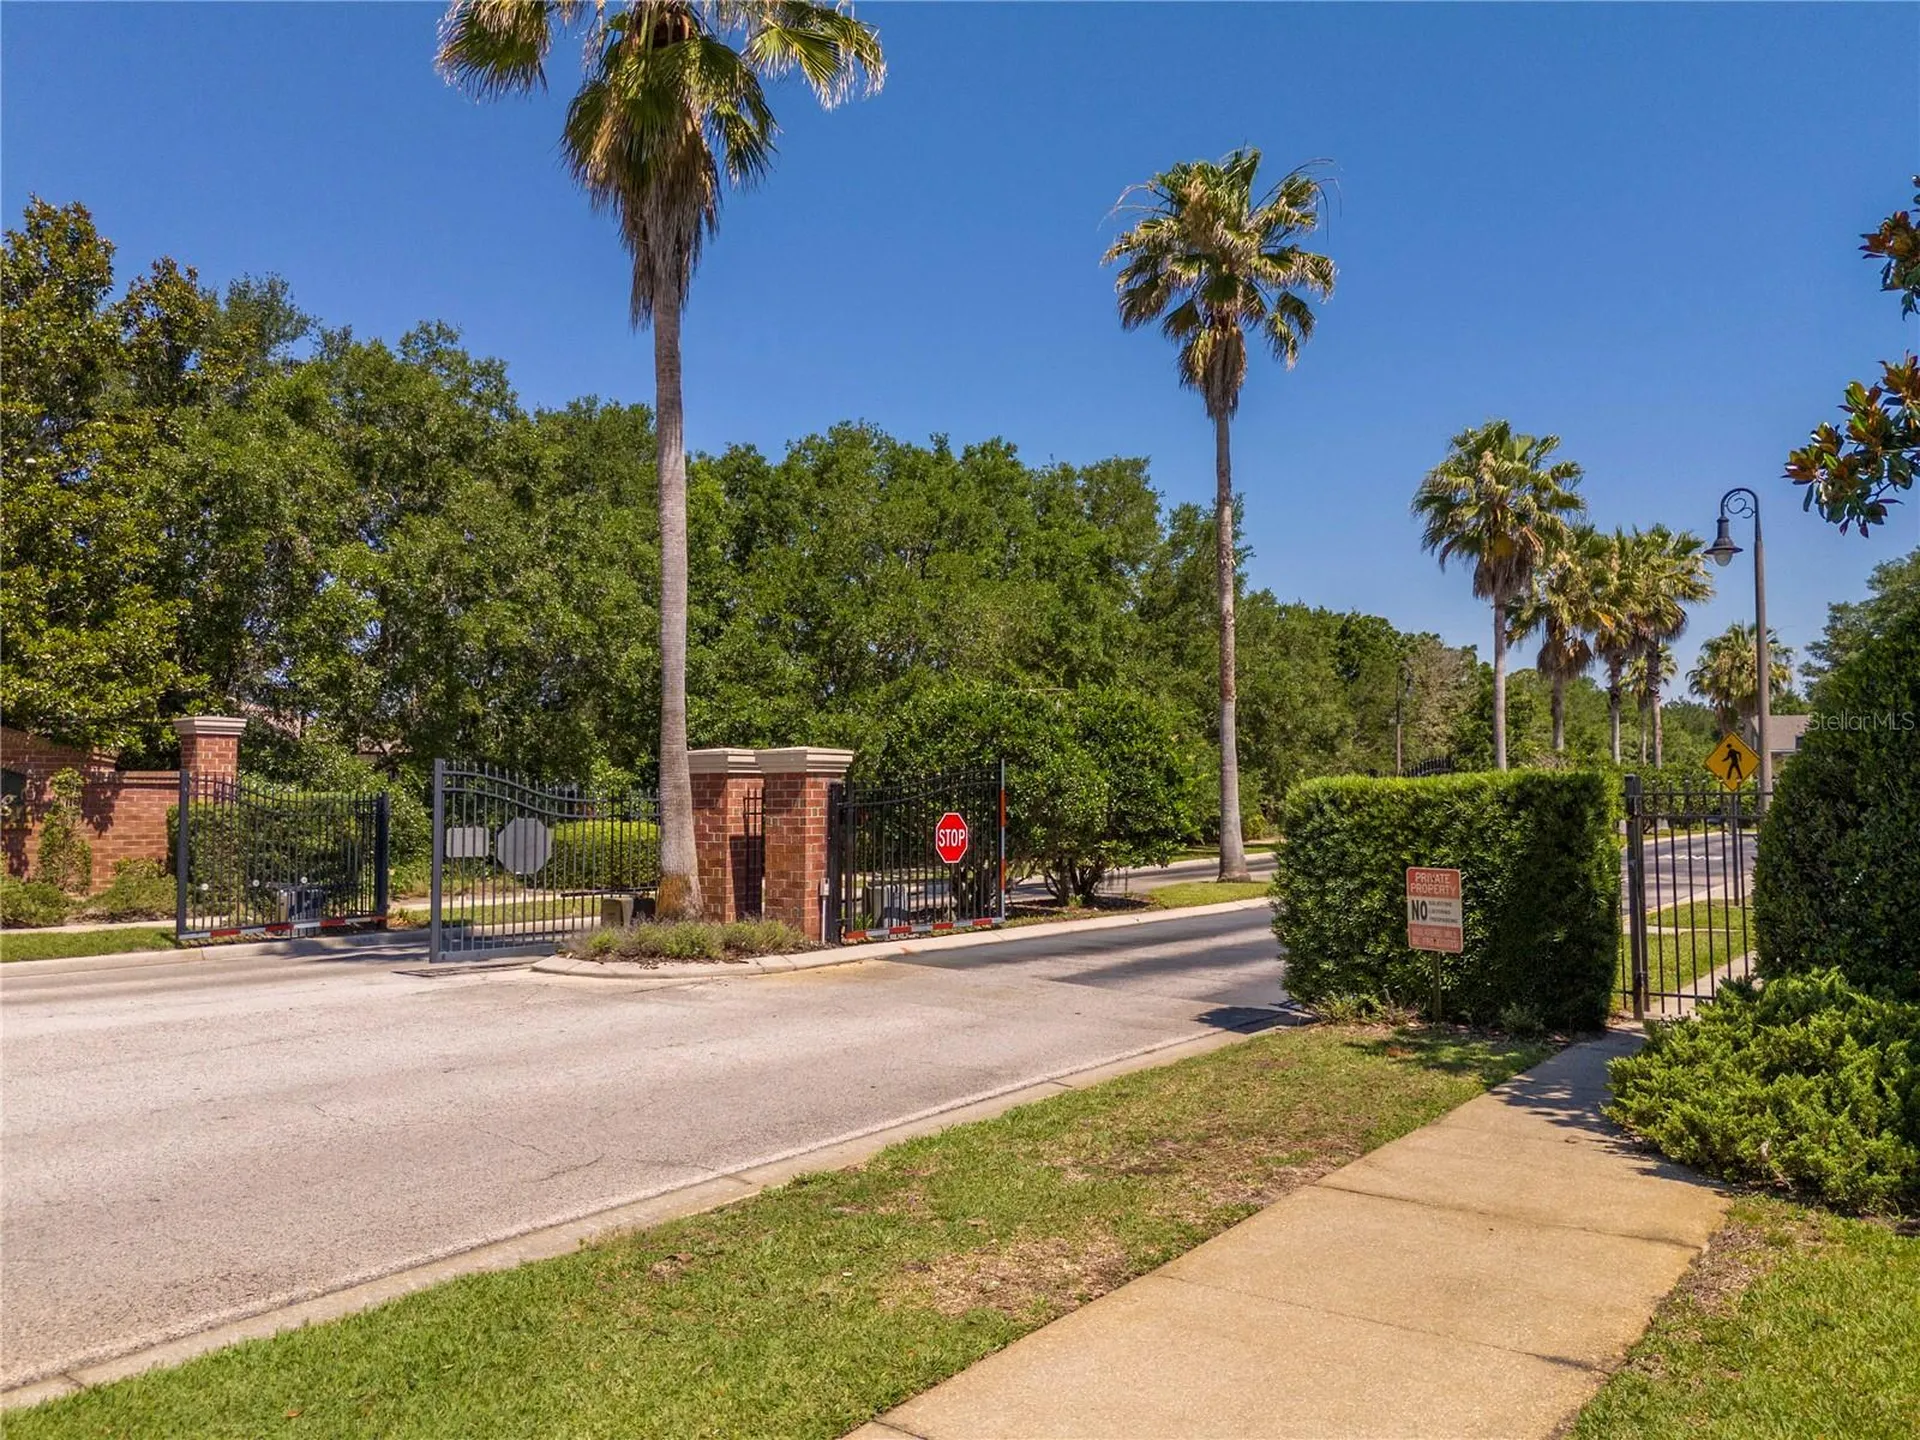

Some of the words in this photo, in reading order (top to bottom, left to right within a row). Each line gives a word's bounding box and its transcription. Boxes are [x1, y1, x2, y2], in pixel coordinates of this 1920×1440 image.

[938, 828, 966, 847] STOP
[1415, 872, 1450, 884] PRIVATE
[1410, 883, 1457, 895] PROPERTY
[1411, 899, 1428, 921] NO
